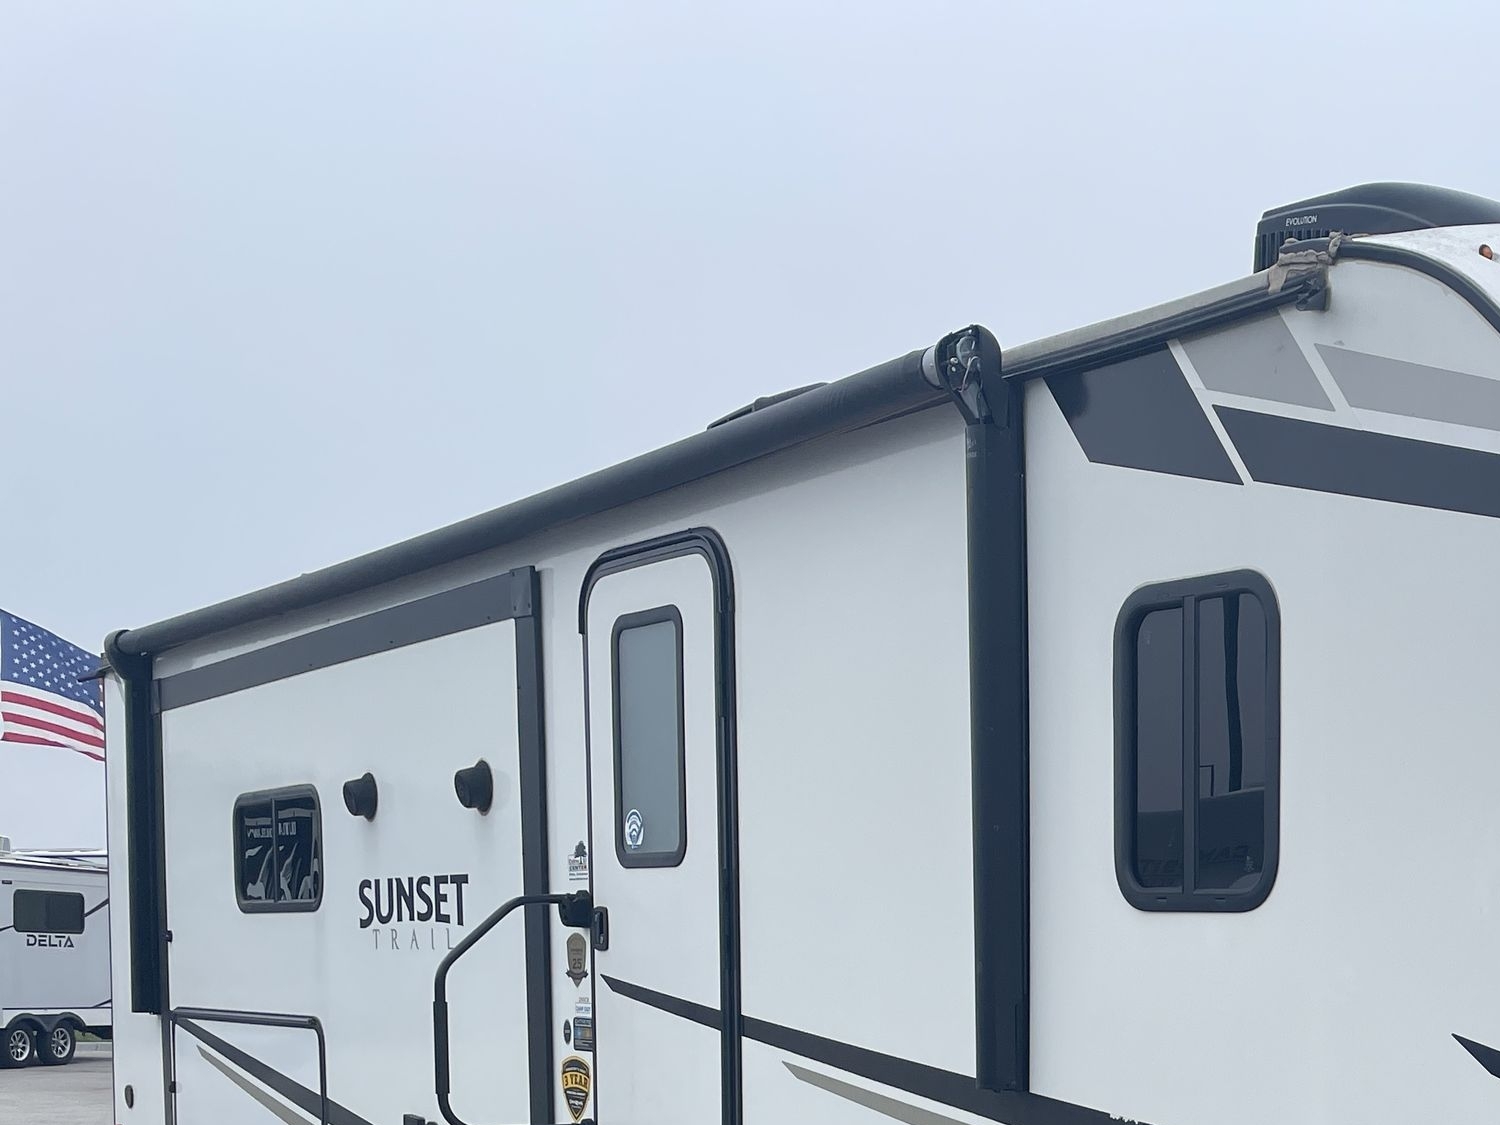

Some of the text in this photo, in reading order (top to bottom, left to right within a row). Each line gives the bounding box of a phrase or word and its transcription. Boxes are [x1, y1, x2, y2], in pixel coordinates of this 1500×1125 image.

[1285, 215, 1318, 227] EVOLUTION
[359, 874, 469, 928] SUNSET
[26, 933, 75, 948] DELTA
[372, 928, 457, 950] TRAIL
[564, 1073, 588, 1090] 3 YEAR
